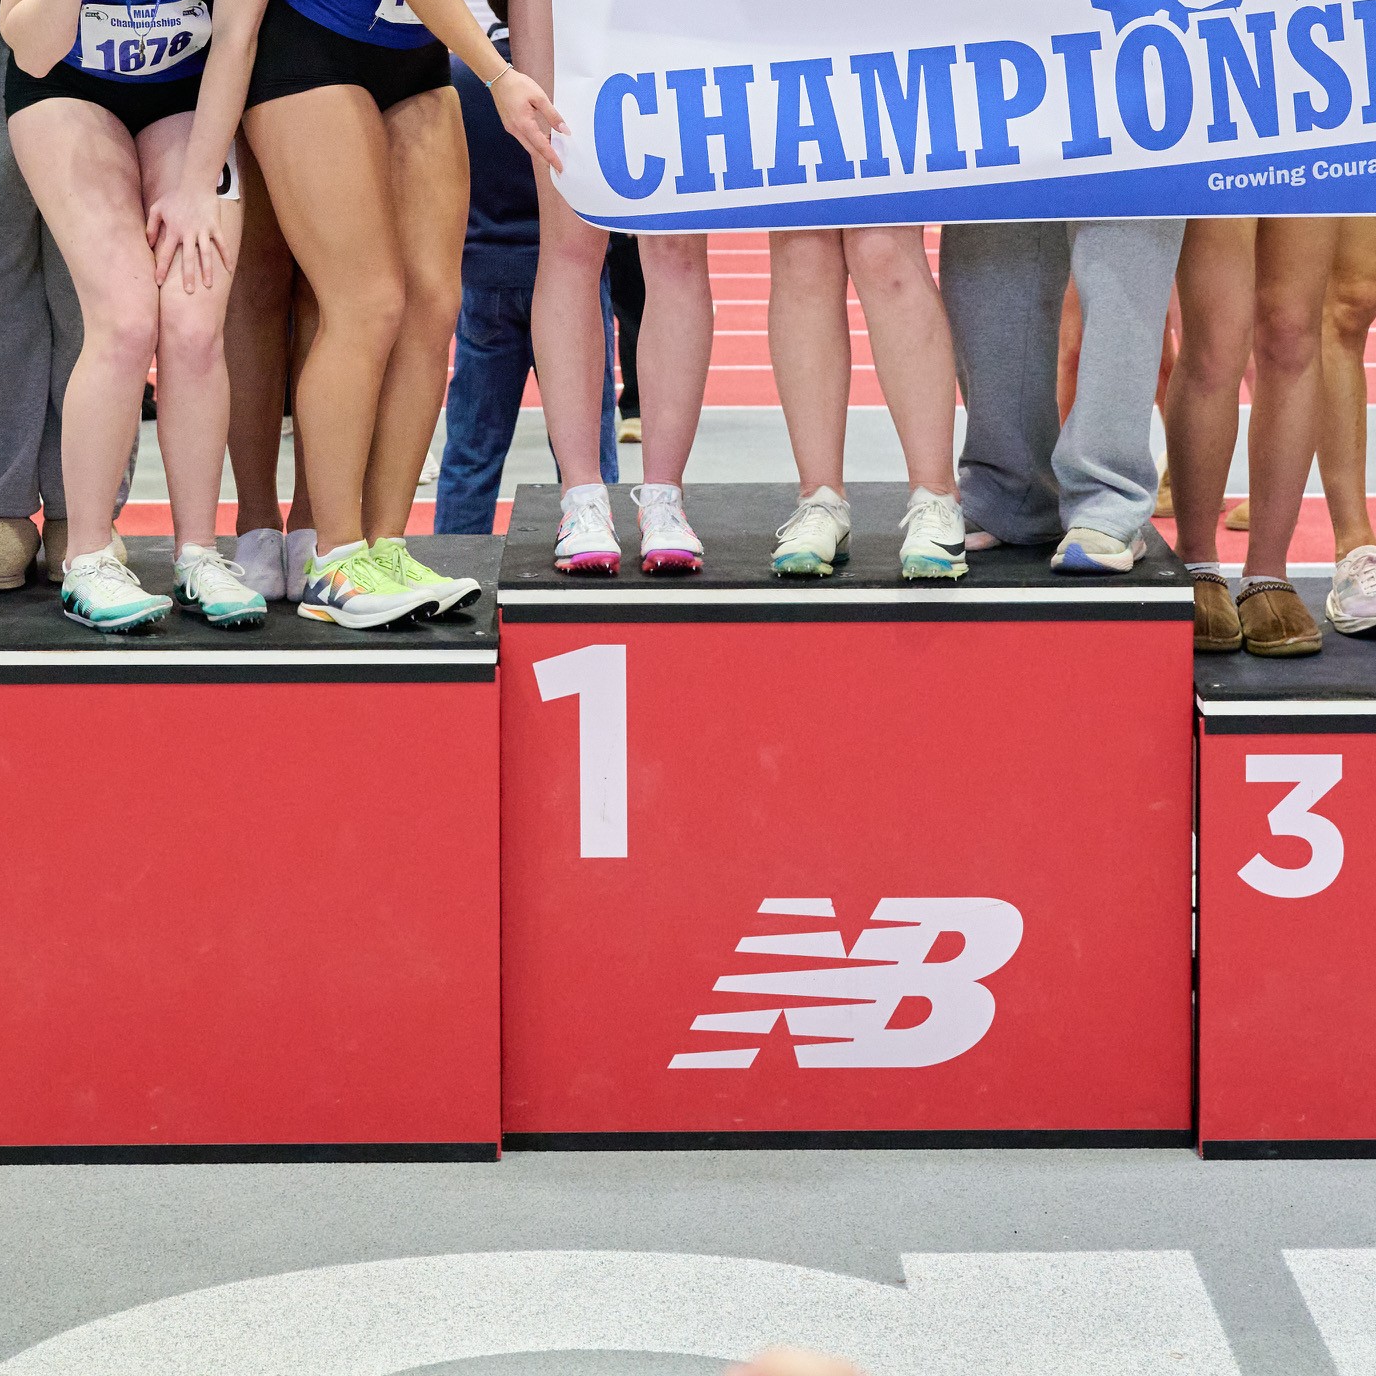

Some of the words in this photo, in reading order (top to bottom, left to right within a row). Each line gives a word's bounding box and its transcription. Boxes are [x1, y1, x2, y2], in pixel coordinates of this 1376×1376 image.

[110, 17, 182, 30] Championships
[95, 30, 194, 72] 1678
[1207, 164, 1306, 191] Growing
[532, 645, 628, 858] 1
[1237, 754, 1345, 899] 3
